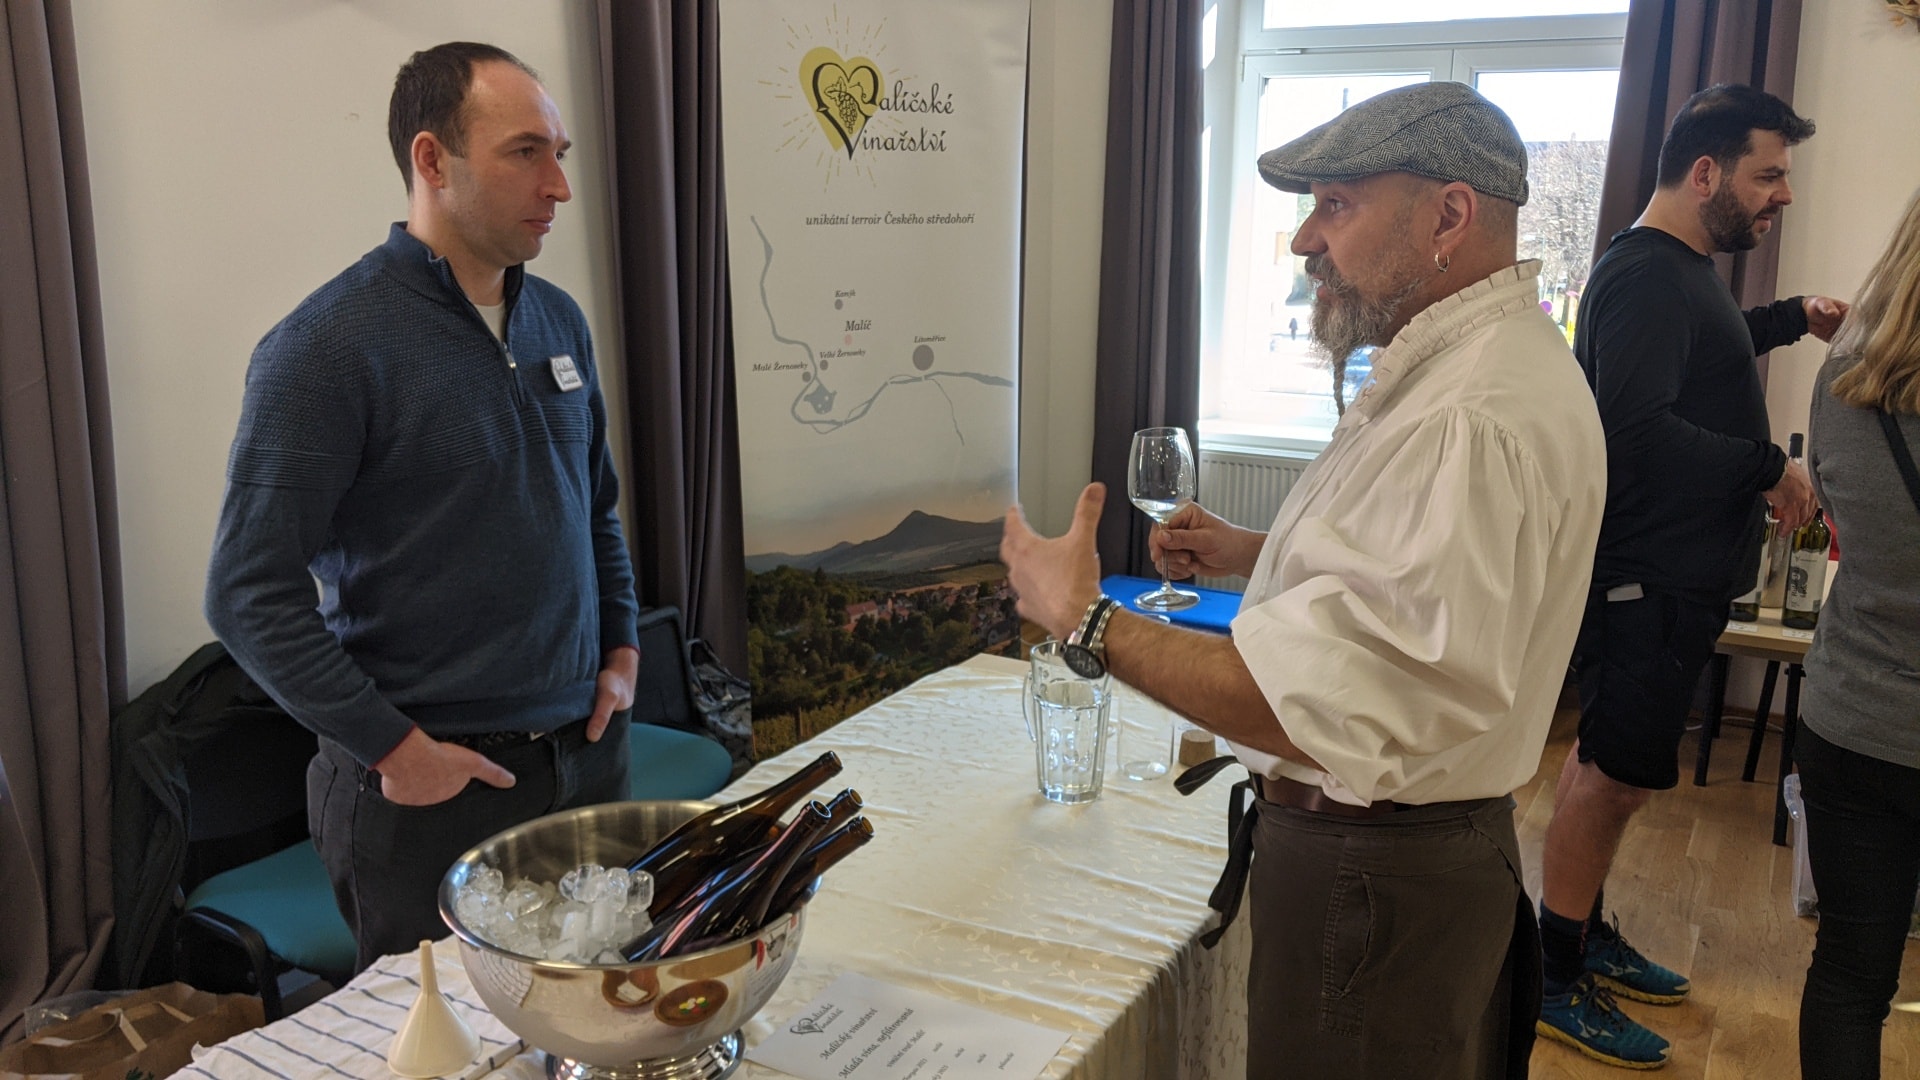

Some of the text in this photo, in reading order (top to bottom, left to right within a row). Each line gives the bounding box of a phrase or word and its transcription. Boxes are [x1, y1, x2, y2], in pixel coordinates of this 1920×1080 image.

[806, 211, 975, 225] unikátní terroir Českého středohoří
